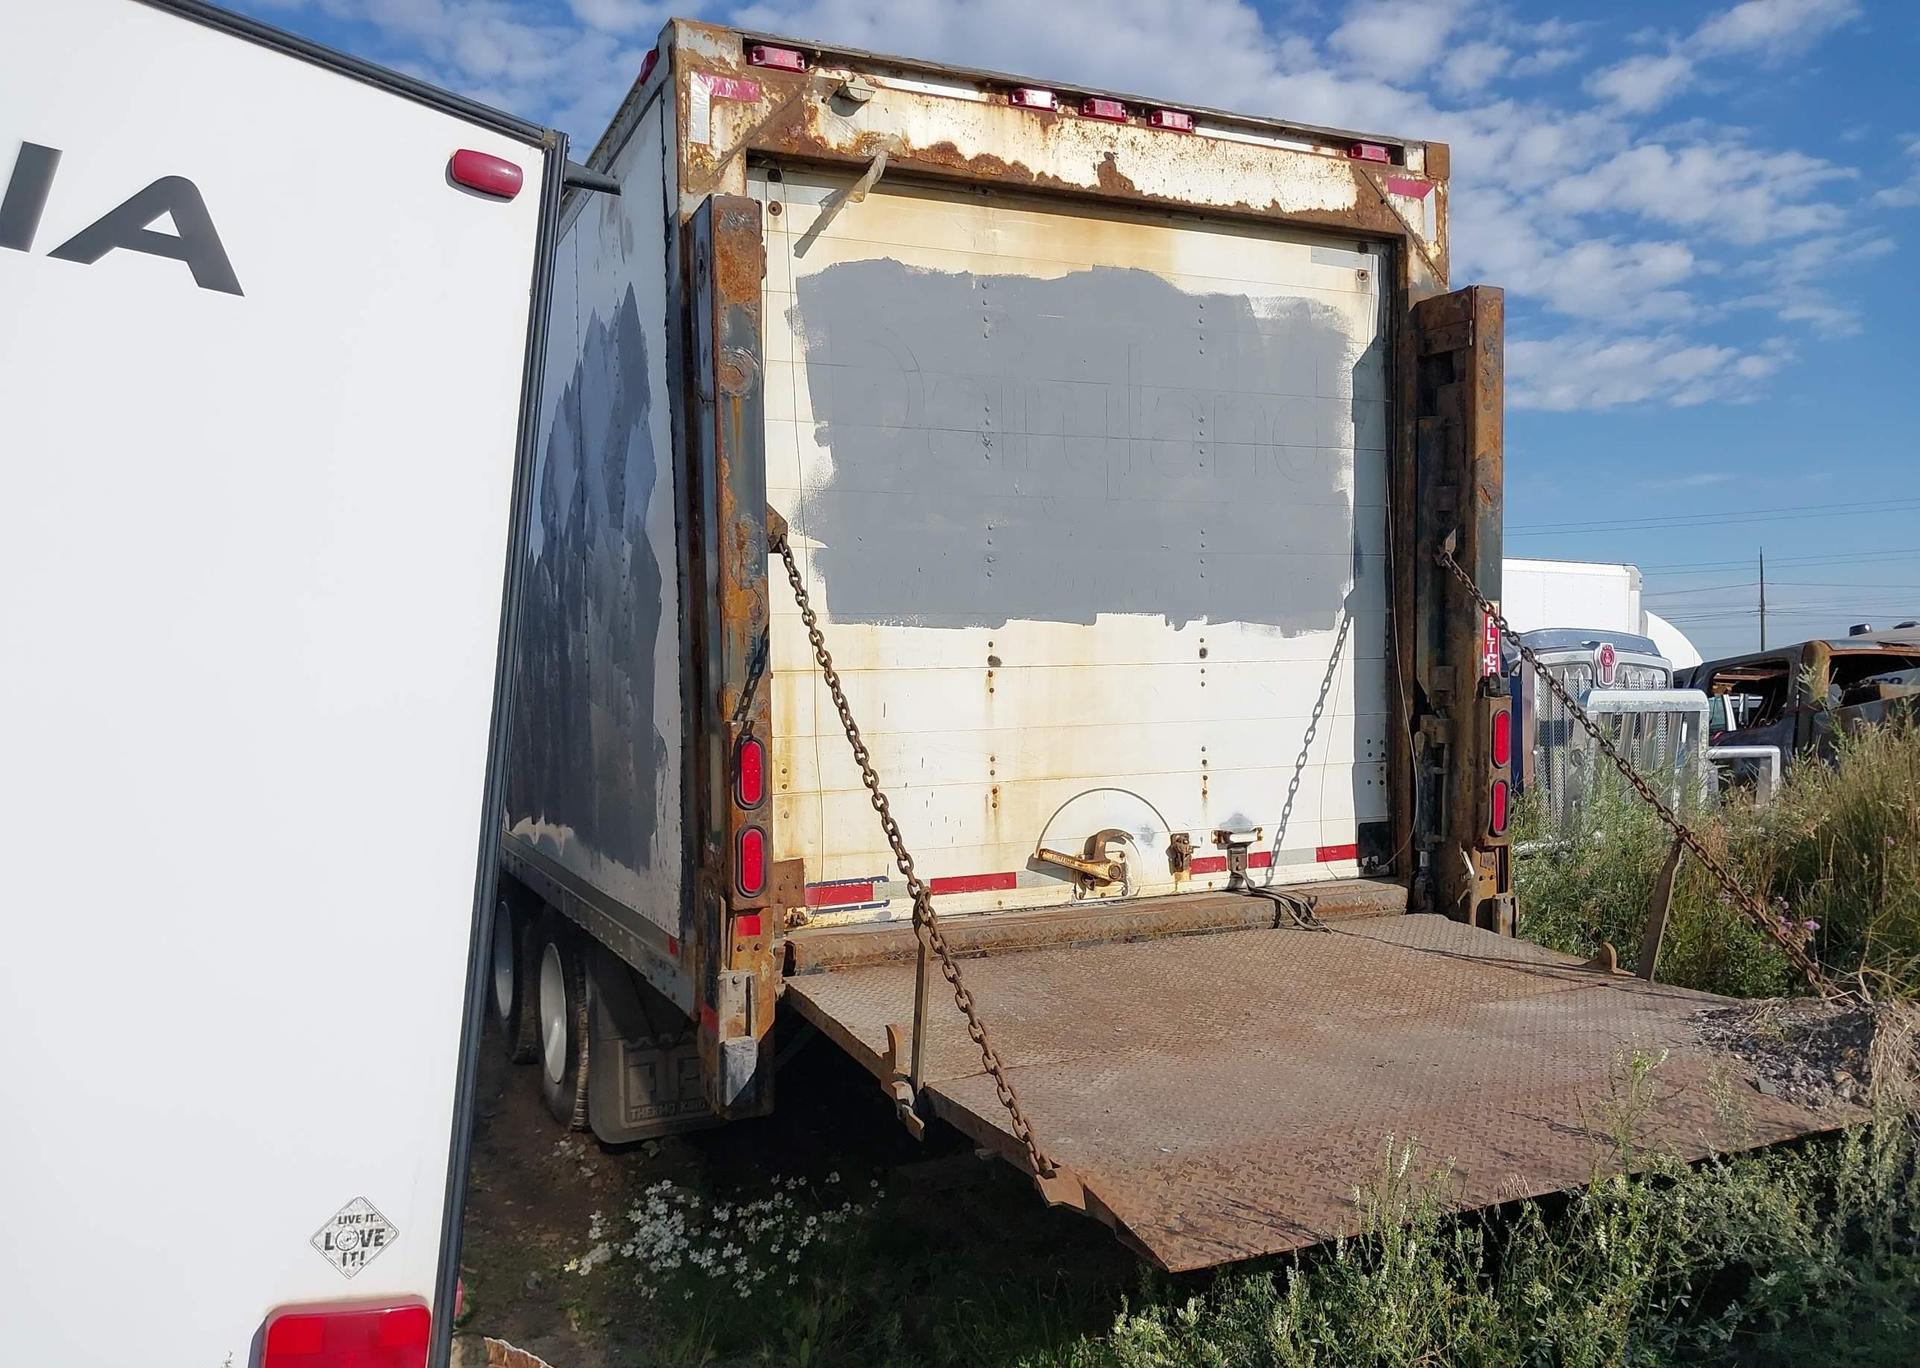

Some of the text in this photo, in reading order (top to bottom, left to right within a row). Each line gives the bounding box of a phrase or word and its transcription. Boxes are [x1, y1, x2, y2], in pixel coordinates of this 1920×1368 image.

[631, 1103, 675, 1120] THERMO
[337, 1214, 362, 1225] LIVE
[324, 1228, 385, 1251] LOVE
[342, 1250, 365, 1267] IT!
